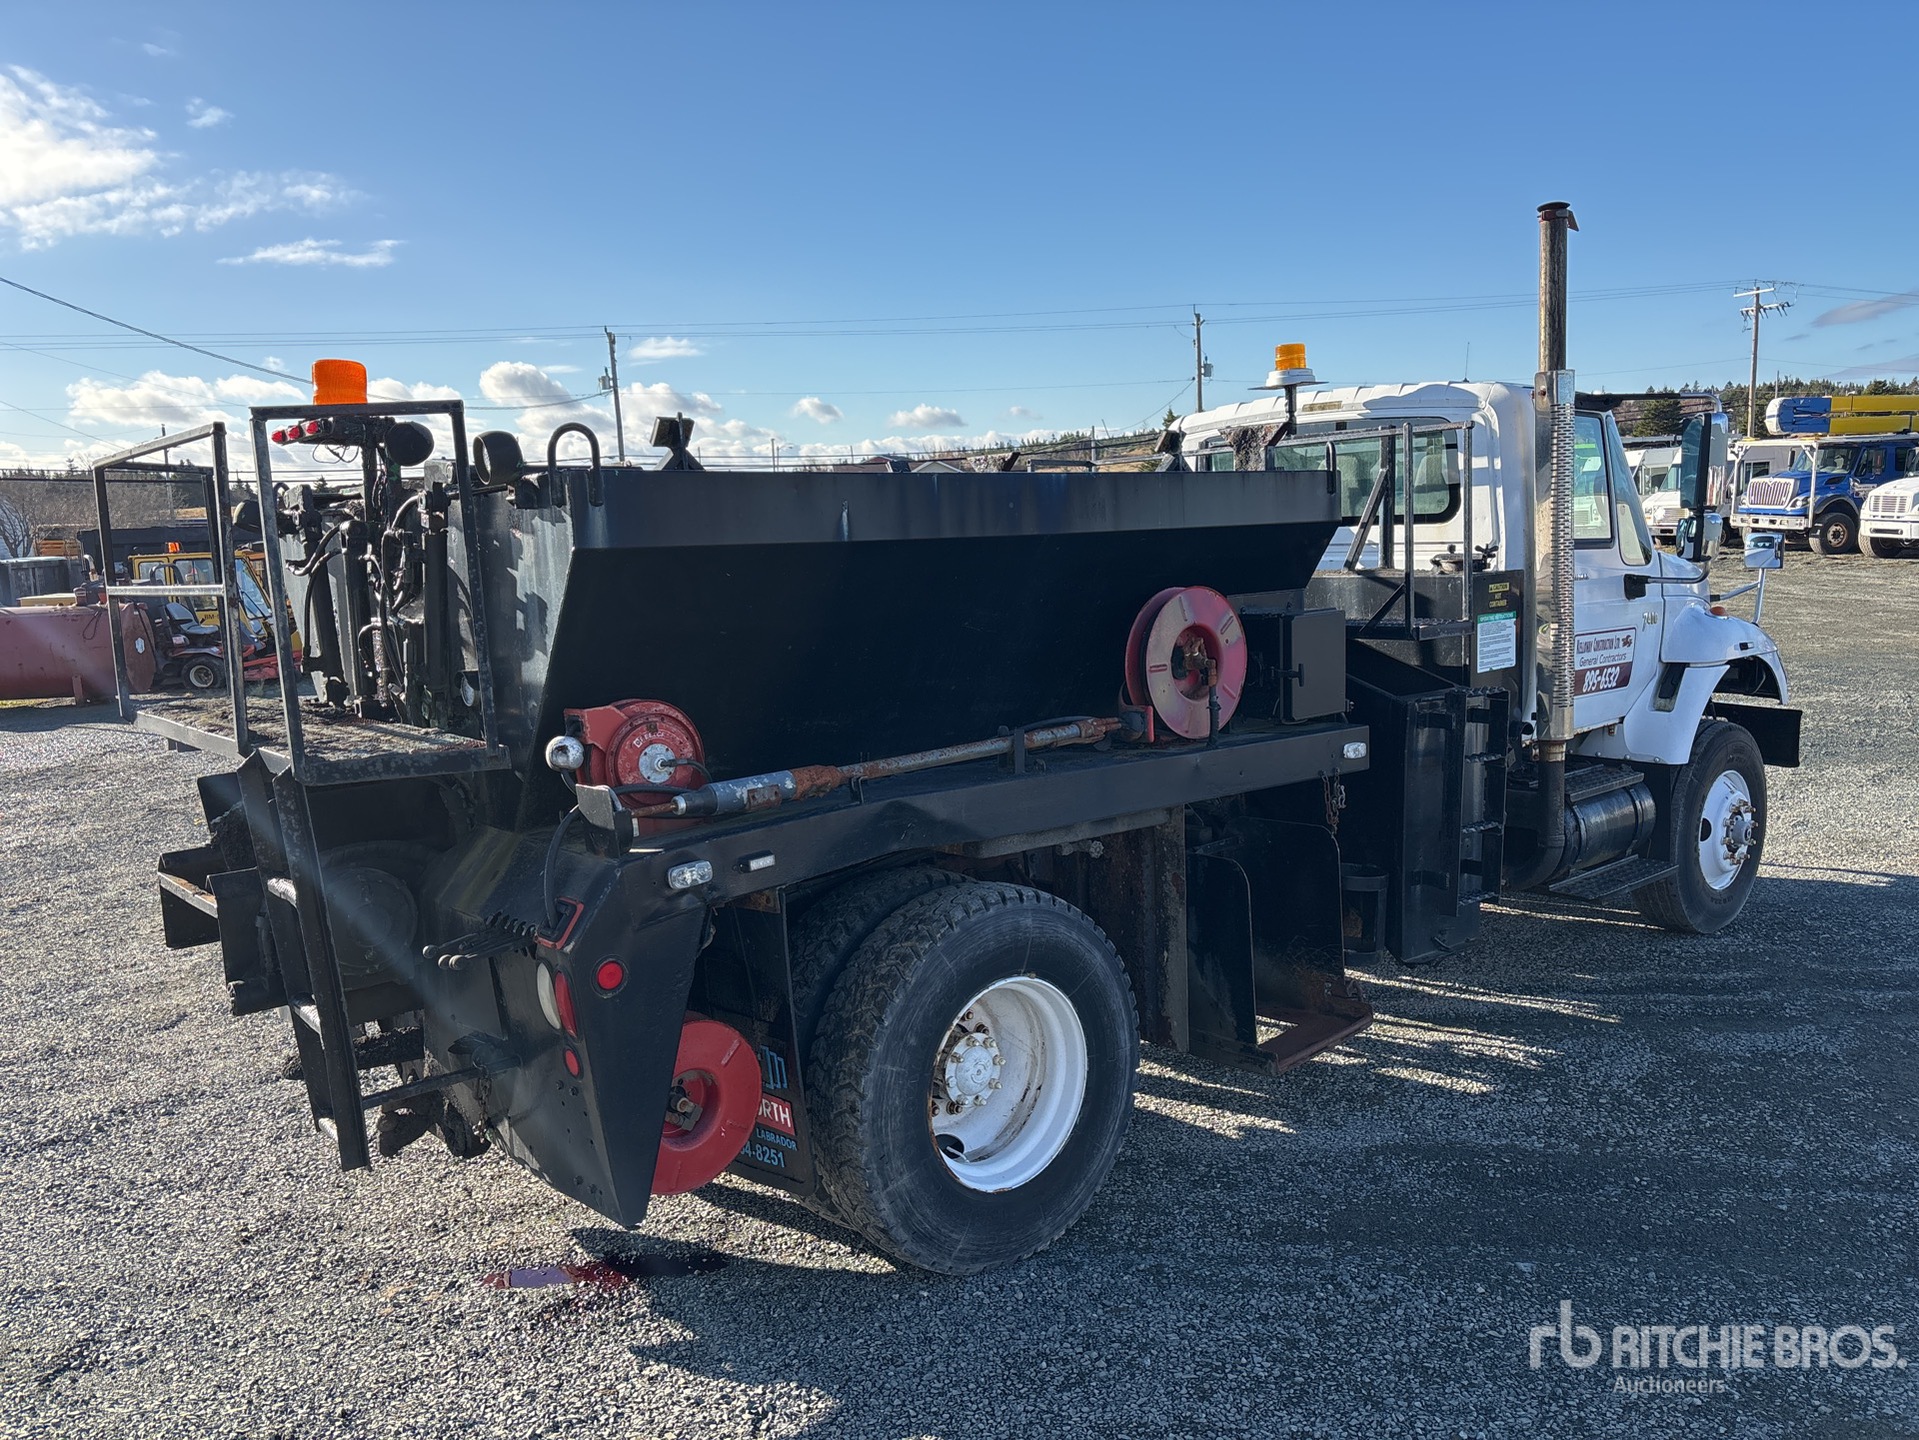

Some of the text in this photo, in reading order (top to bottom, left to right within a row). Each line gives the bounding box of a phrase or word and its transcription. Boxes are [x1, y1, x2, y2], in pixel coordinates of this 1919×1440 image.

[1579, 652, 1627, 667] General Contractors
[1582, 666, 1620, 693] 895-6532
[756, 1127, 798, 1152] LABRADOR
